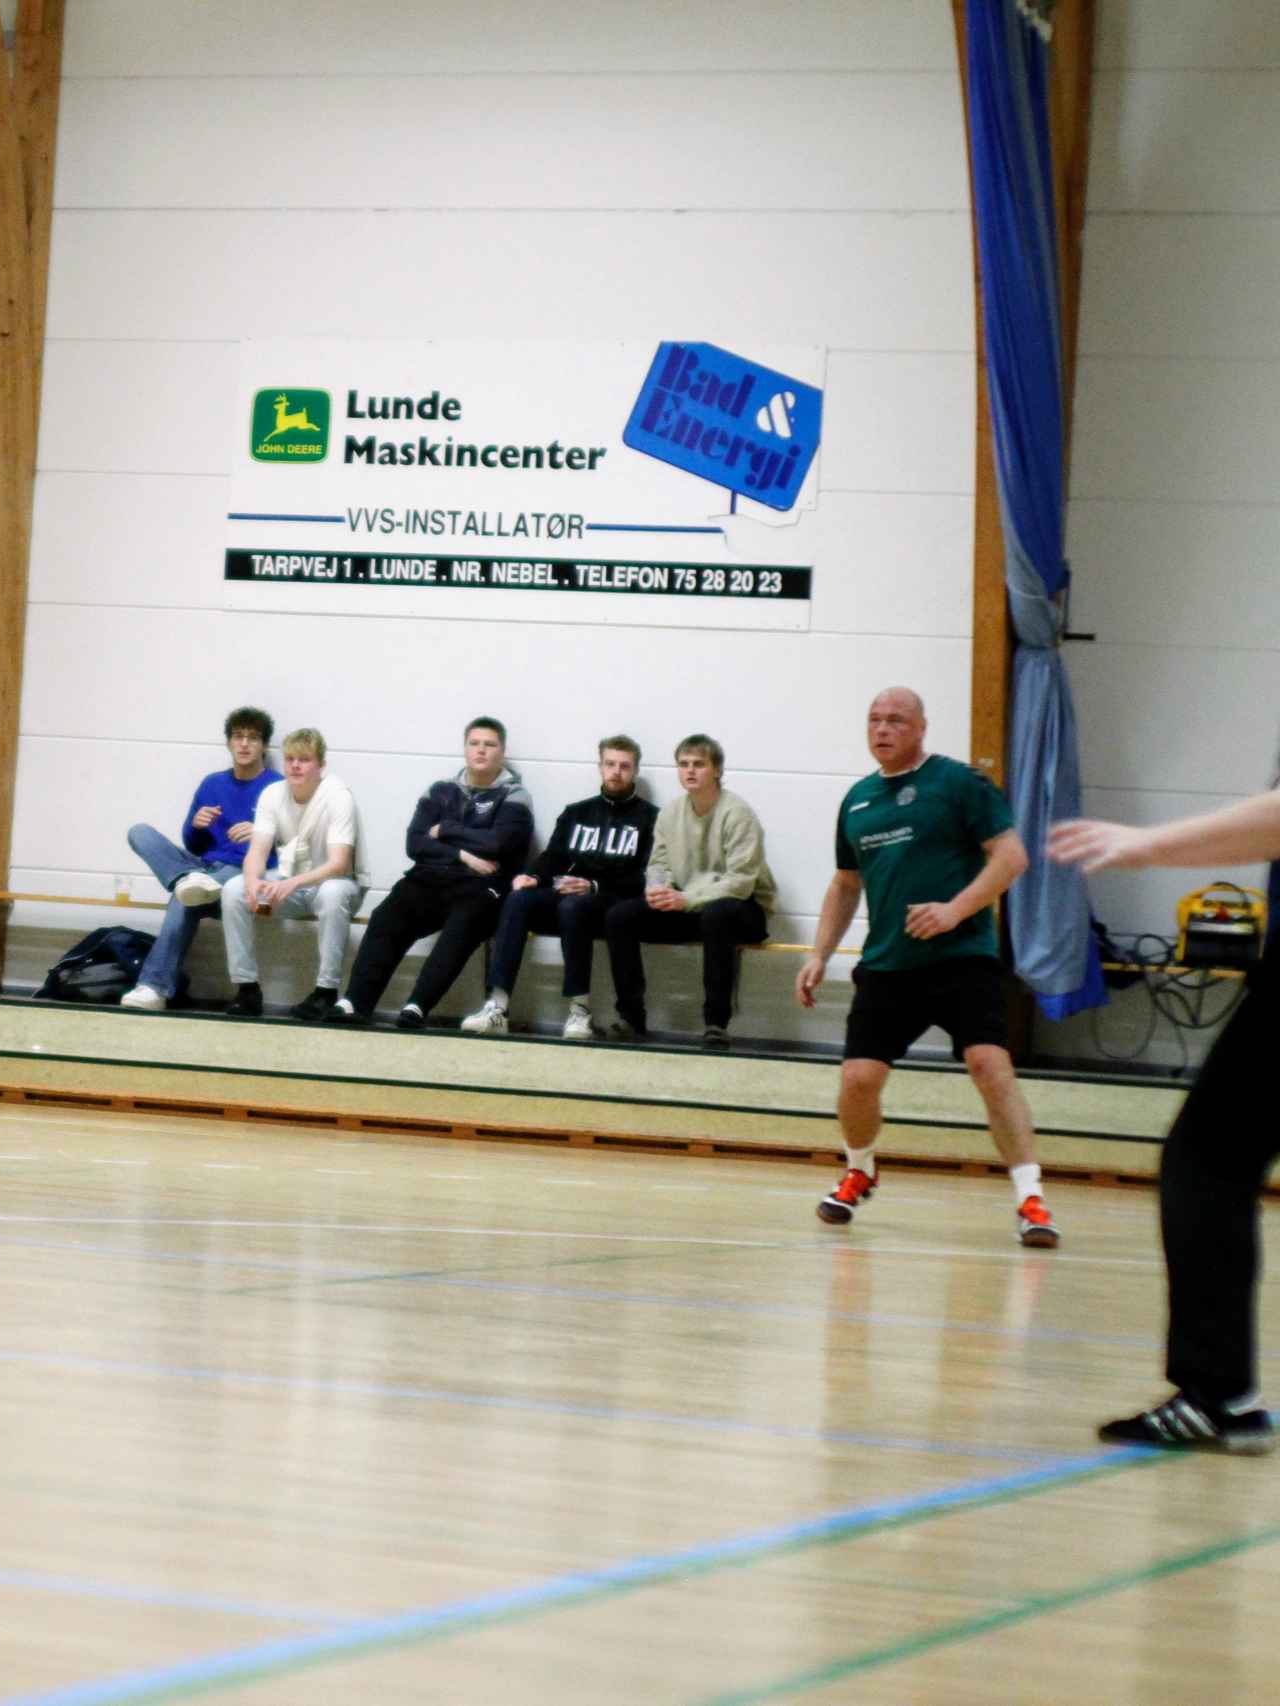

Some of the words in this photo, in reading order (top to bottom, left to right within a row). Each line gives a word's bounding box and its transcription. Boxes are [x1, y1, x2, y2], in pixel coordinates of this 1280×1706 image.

[346, 390, 461, 421] Lunde
[658, 345, 756, 418] Bad
[756, 391, 795, 438] &
[255, 443, 285, 454] JOHN
[287, 443, 322, 455] DEERE
[344, 435, 608, 470] Maskincenter
[640, 389, 802, 490] Energi
[347, 507, 585, 539] VVS-INSTALLATØR
[251, 554, 337, 578] TARPVEJ
[343, 557, 352, 577] 1
[370, 558, 437, 580] LUNDE
[452, 560, 486, 582] NR.
[492, 562, 558, 586] NEBEL
[575, 564, 668, 589] TELEFON
[674, 568, 697, 590] 75
[702, 569, 726, 591] 28
[730, 570, 754, 592] 20
[758, 571, 782, 593] 23
[569, 823, 640, 857] ITALIA
